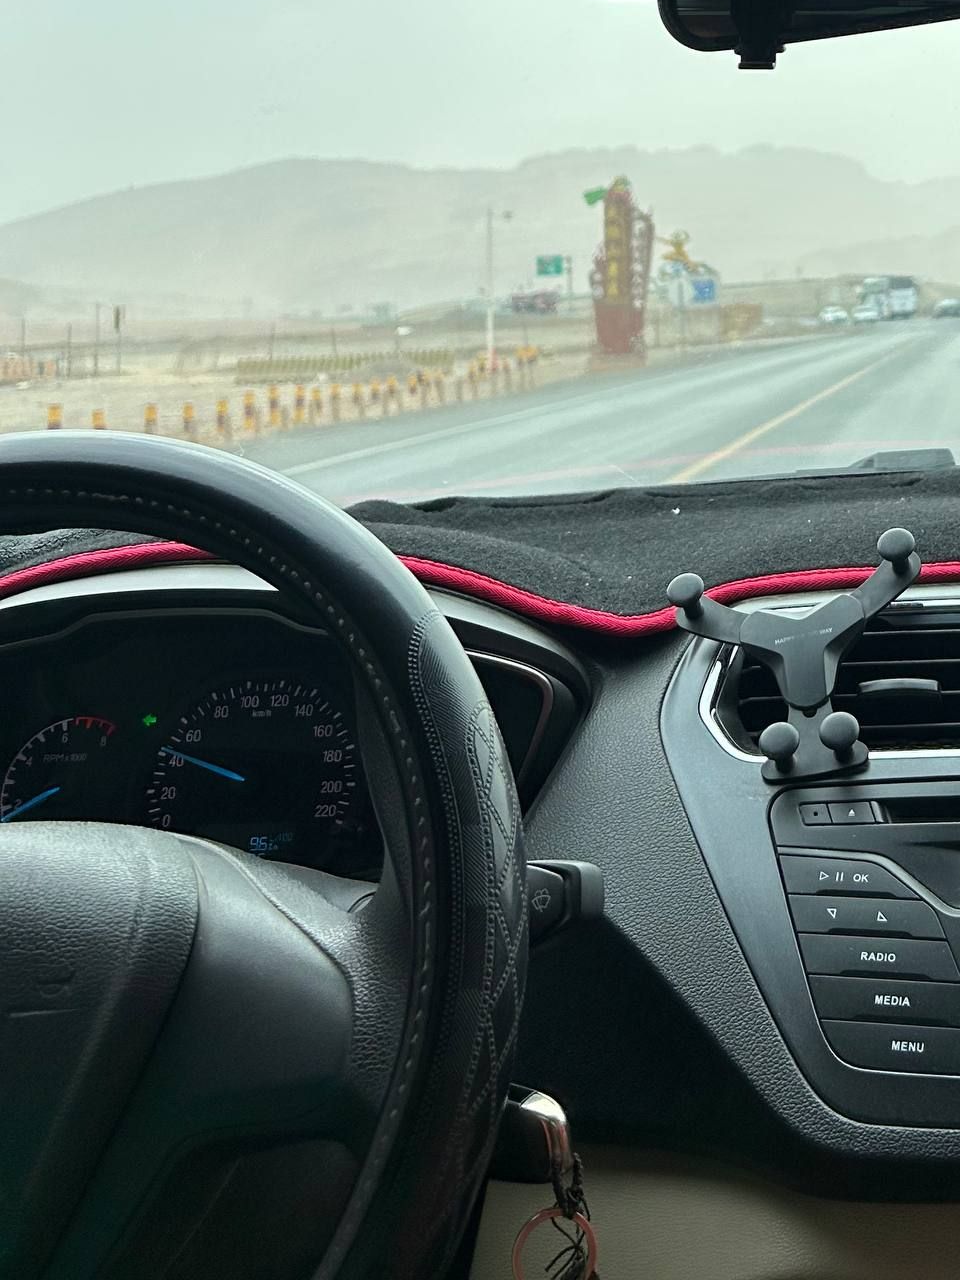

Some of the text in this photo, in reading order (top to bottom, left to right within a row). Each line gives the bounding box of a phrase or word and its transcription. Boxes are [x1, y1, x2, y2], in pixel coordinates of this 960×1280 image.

[240, 695, 259, 708] 100
[270, 694, 289, 707] 120
[214, 705, 229, 718] 80
[294, 703, 313, 717] 140
[185, 729, 201, 742] 60
[313, 724, 332, 737] 160
[168, 755, 184, 767] 40
[323, 749, 342, 762] 180
[321, 780, 342, 793] 200
[160, 787, 176, 800] 20
[314, 805, 336, 818] 220
[162, 814, 171, 827] 0
[853, 873, 869, 883] OK
[860, 951, 896, 962] RADIO
[874, 994, 911, 1007] MEDIA
[891, 1040, 925, 1053] MENU
